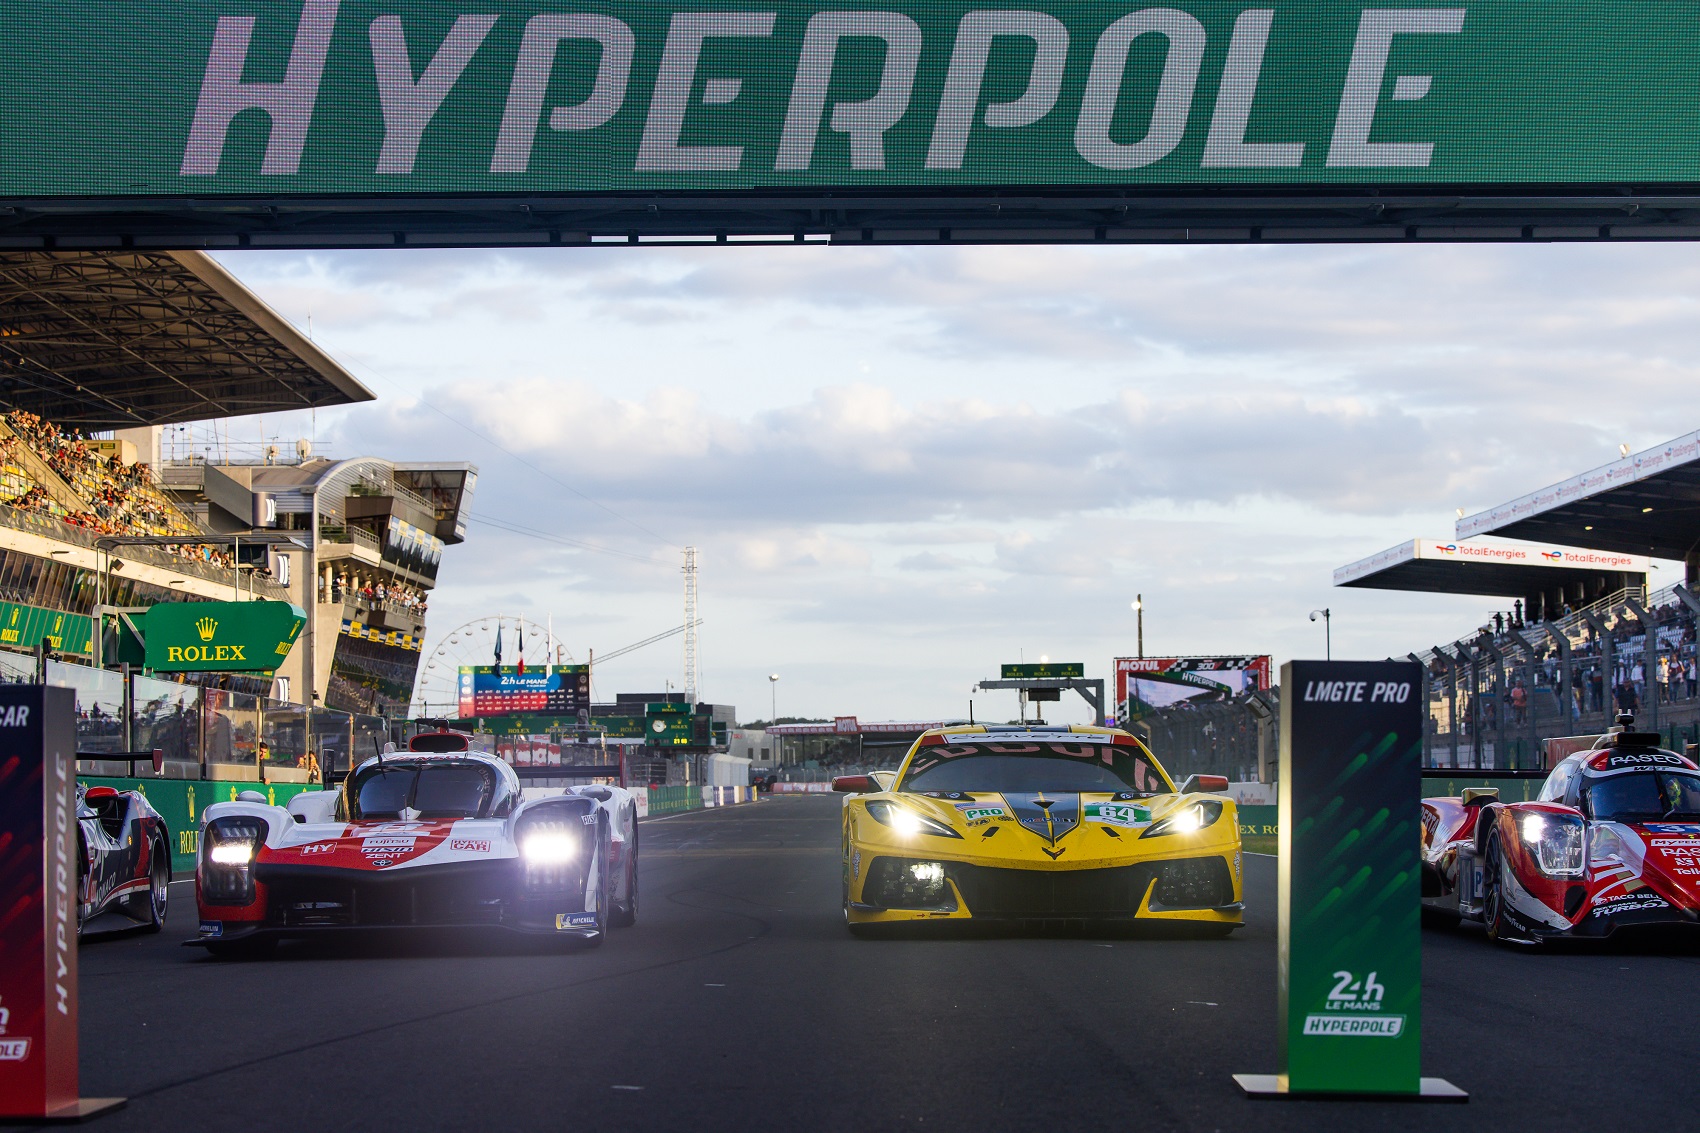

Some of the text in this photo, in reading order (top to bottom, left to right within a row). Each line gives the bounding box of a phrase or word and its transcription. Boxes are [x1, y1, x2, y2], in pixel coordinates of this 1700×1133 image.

[179, 0, 1467, 176] HYPERPOLE
[1458, 546, 1527, 560] TotalEnergies
[1564, 553, 1632, 566] TotalEnergies
[167, 645, 247, 662] ROLEX
[1118, 660, 1160, 671] MOTUL
[1303, 681, 1411, 704] LMGTE PRO
[1610, 754, 1683, 766] PASEO
[966, 808, 1003, 820] PRO
[1098, 806, 1138, 823] 64
[303, 843, 334, 854] HY
[453, 843, 488, 851] CAR
[55, 752, 68, 1015] HYPERPOLE
[1607, 894, 1636, 902] TACO
[1325, 1001, 1381, 1011] LE MANS
[1309, 1019, 1397, 1034] HYPERPOLE
